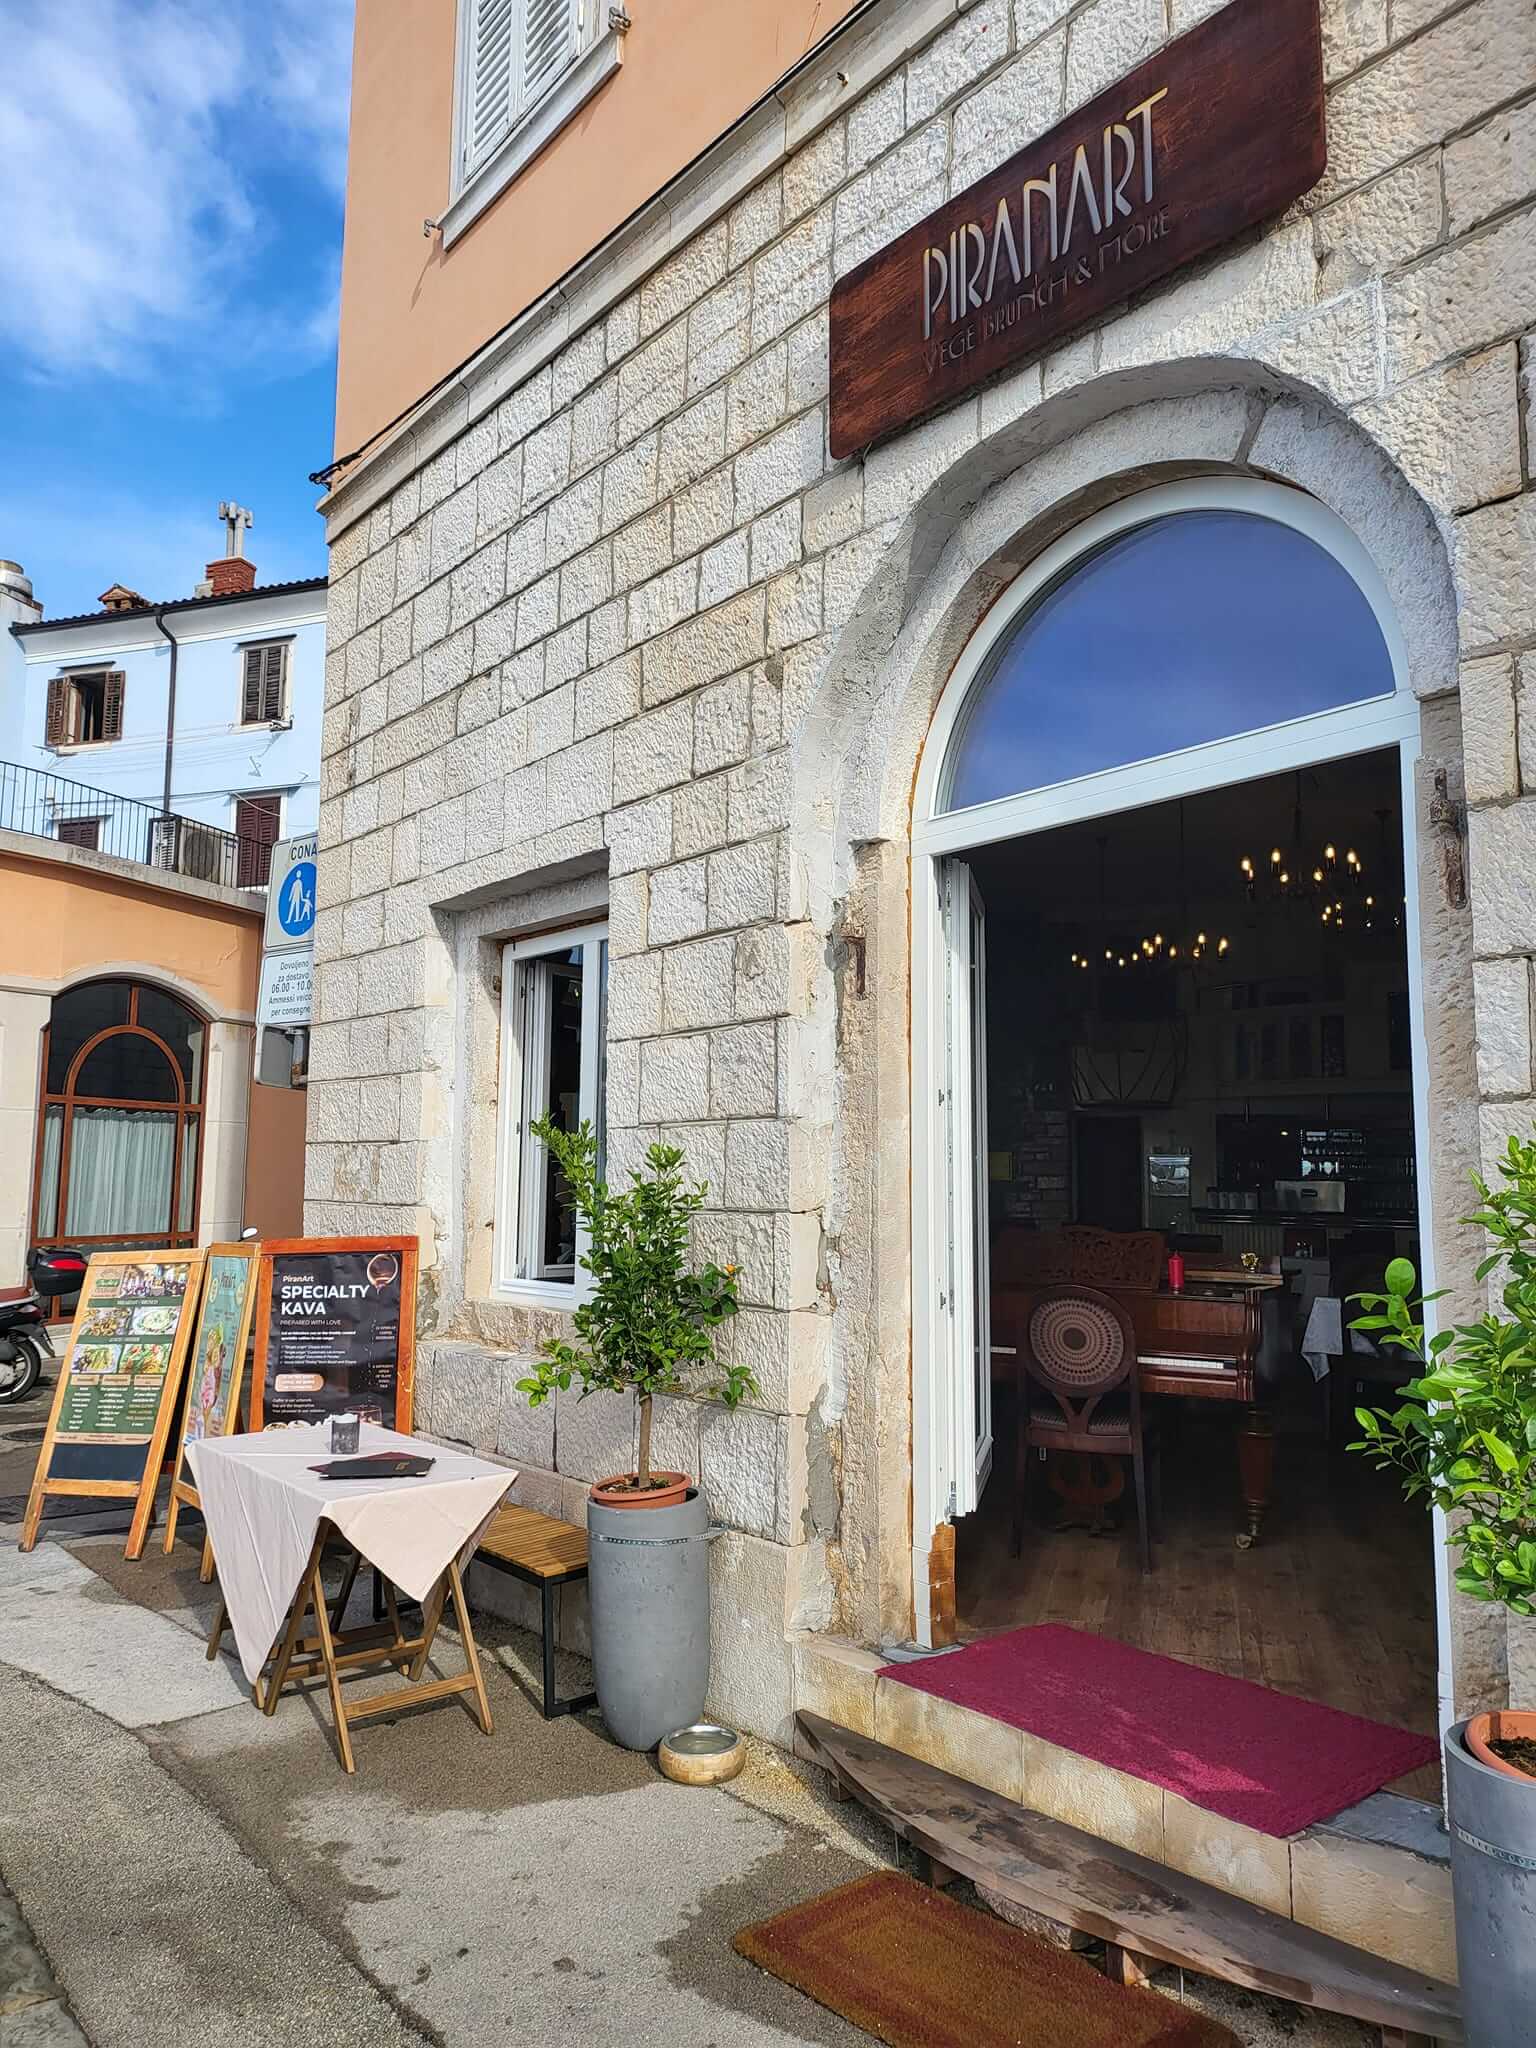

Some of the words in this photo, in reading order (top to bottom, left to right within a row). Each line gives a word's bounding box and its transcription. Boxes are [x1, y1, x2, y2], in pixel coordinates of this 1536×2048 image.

[923, 87, 1168, 341] PIRANART
[921, 323, 977, 376] VEGE
[1074, 256, 1092, 285] &
[1099, 204, 1169, 273] MORE
[291, 843, 317, 861] CONA
[271, 982, 290, 994] 06.00
[282, 1275, 314, 1283] PiranArt
[281, 1285, 369, 1299] SPECIALTY
[281, 1302, 326, 1316] KAVA
